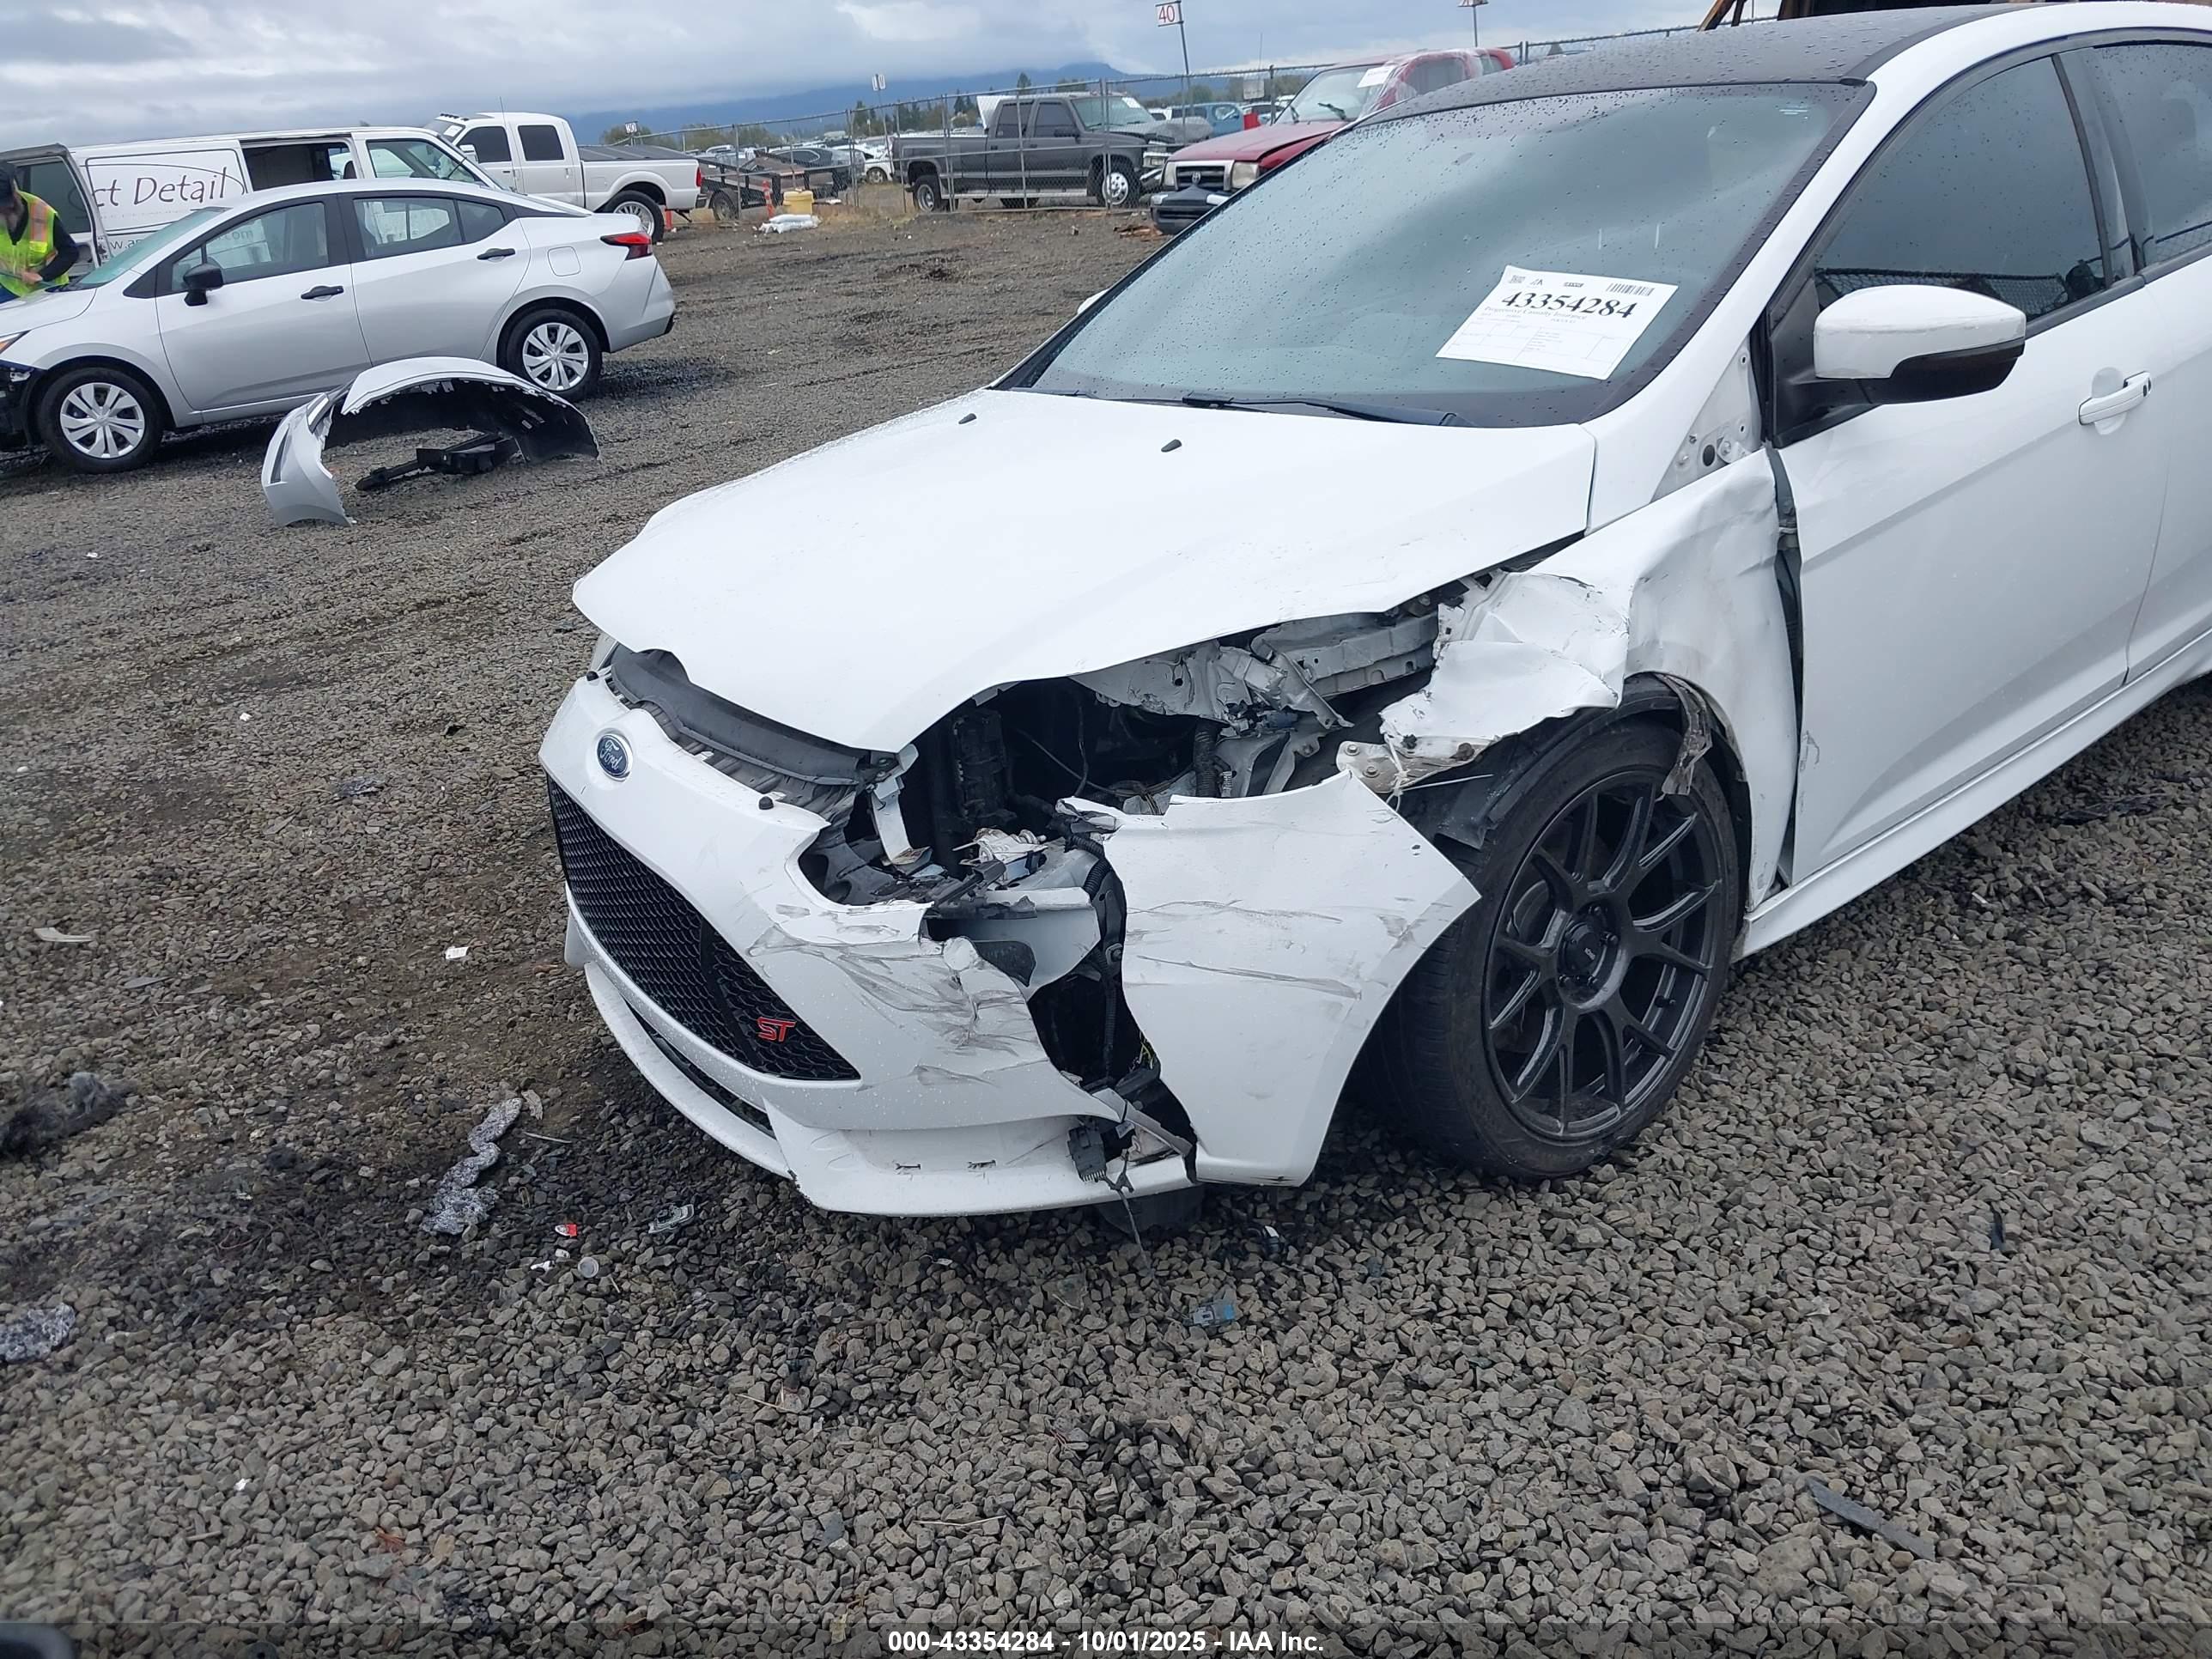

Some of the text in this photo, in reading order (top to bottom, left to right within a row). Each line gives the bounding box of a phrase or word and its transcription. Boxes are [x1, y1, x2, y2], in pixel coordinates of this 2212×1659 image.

[1158, 5, 1176, 22] 40
[133, 166, 228, 205] Detail
[1501, 291, 1638, 319] 43354284
[599, 739, 623, 770] Ford
[757, 1016, 798, 1042] ST
